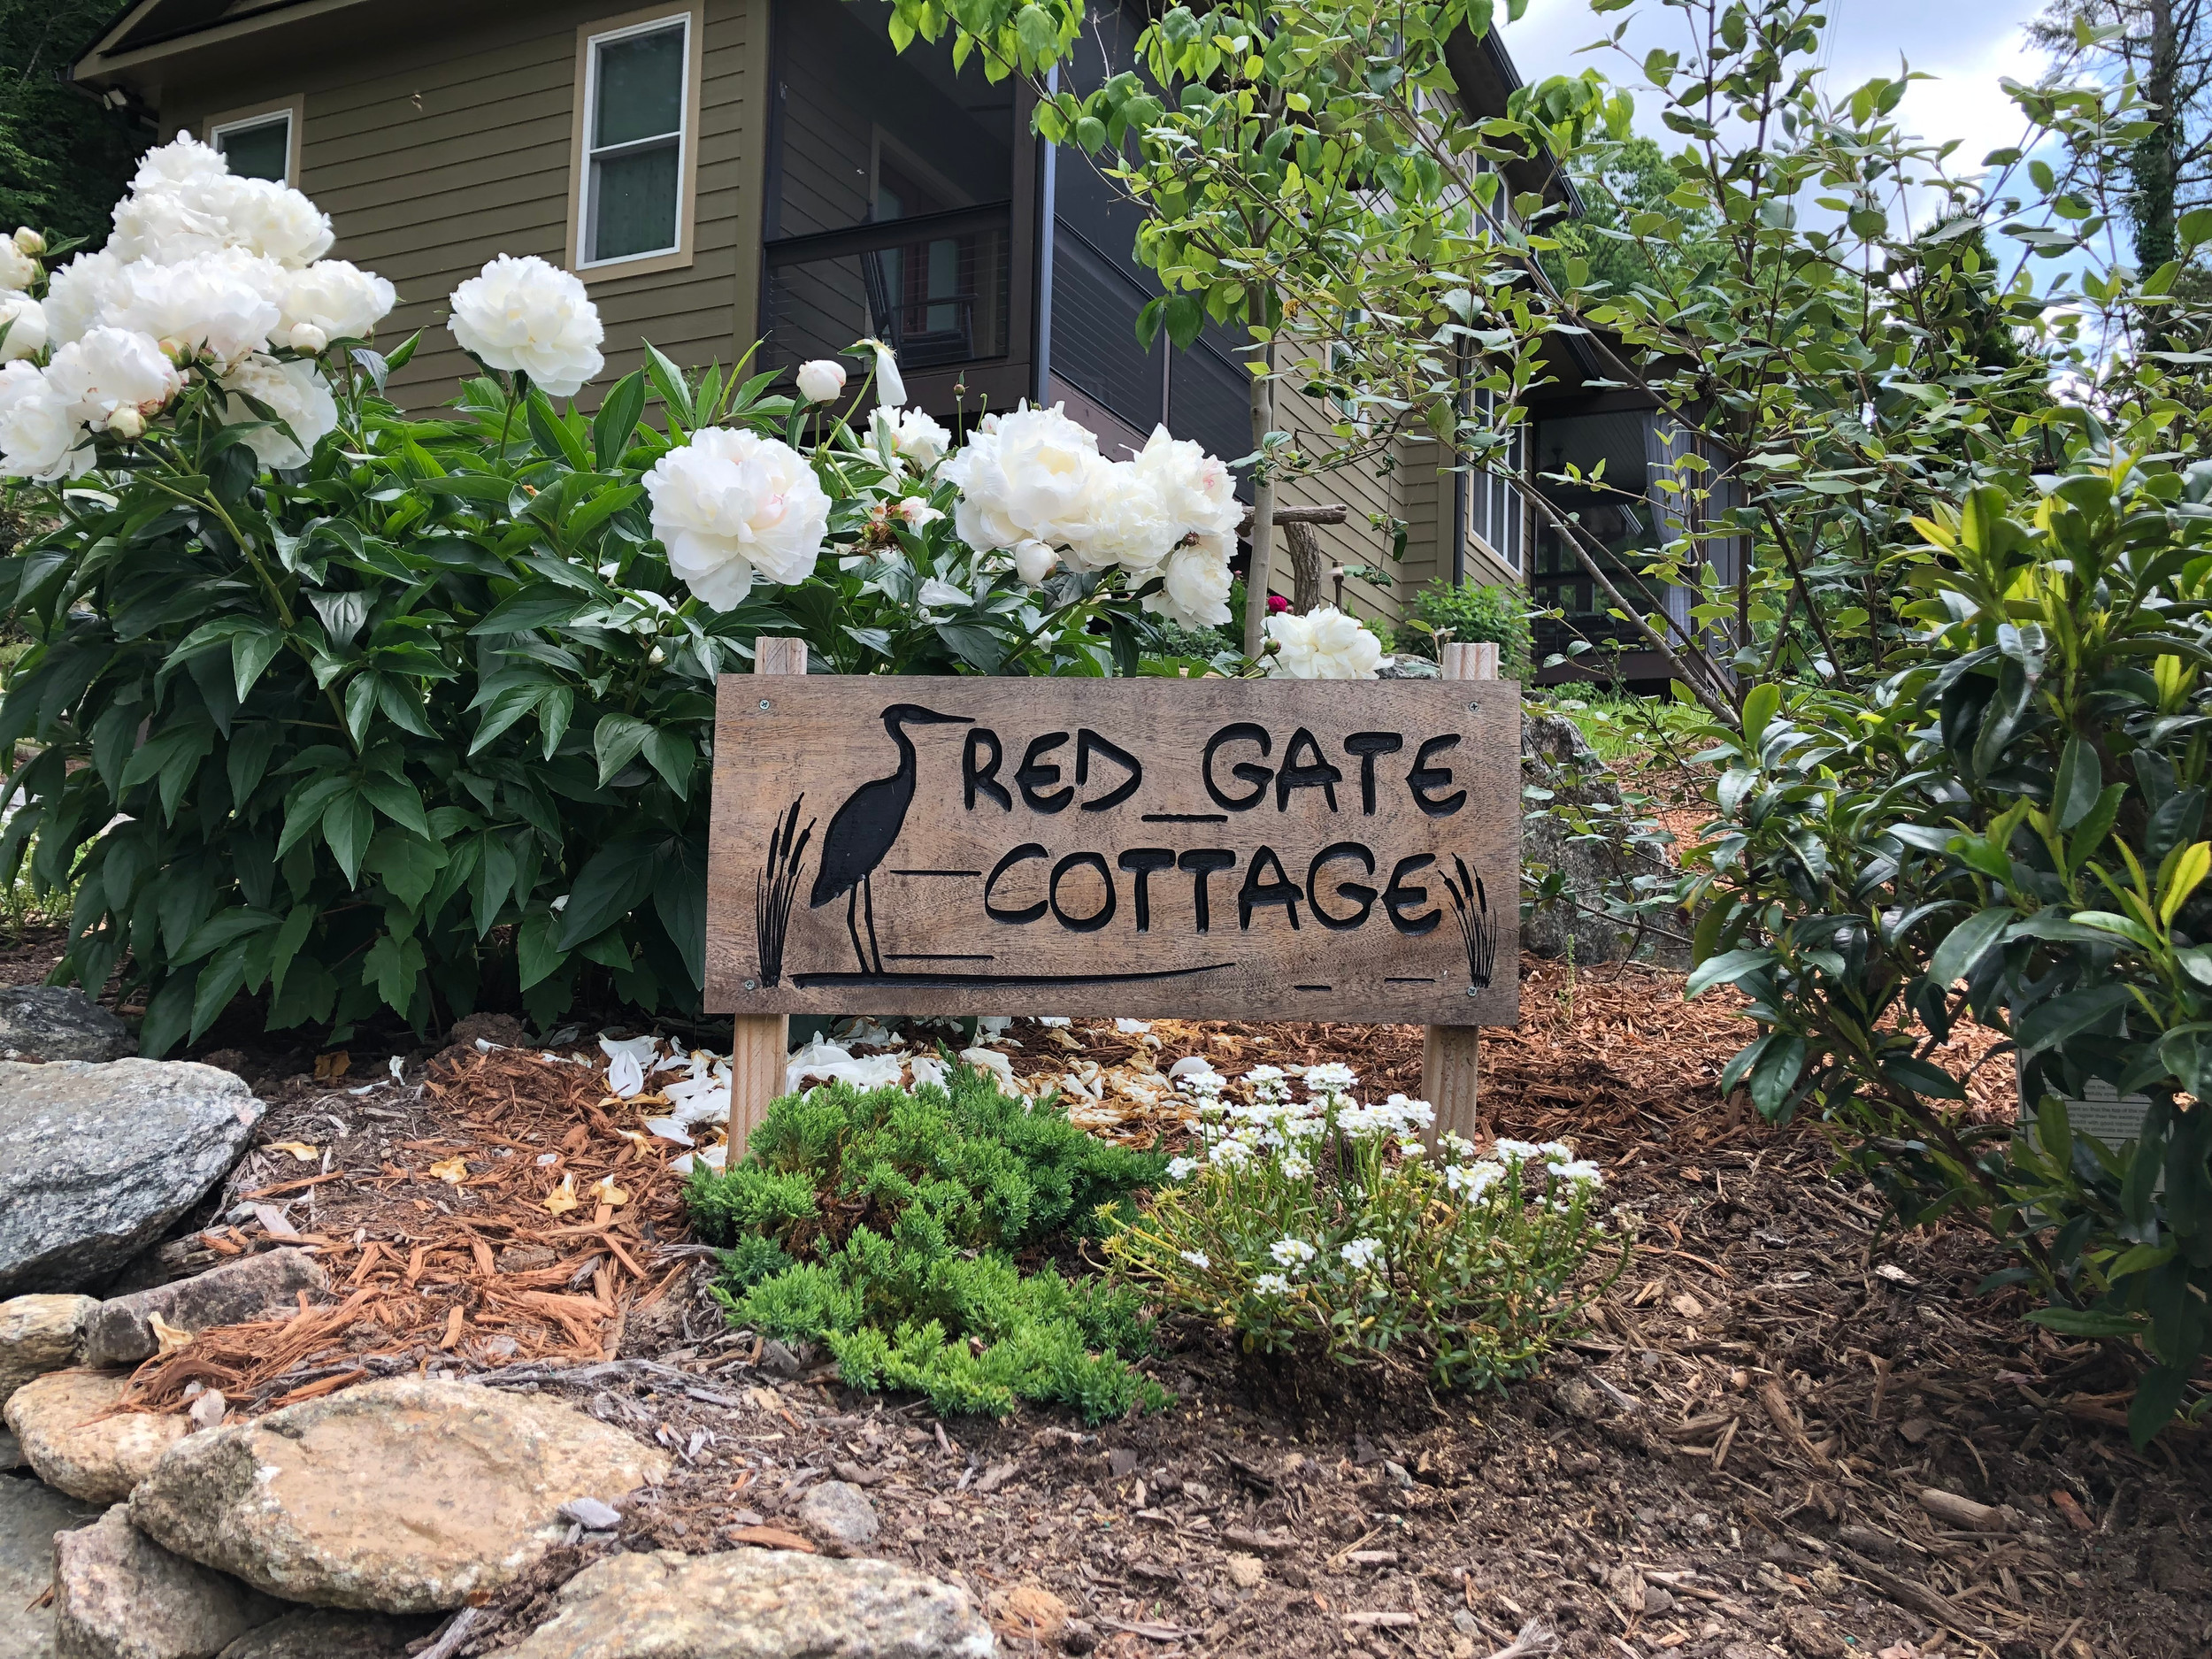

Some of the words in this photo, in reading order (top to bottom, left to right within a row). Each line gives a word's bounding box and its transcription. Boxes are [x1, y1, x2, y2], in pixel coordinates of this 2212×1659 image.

[963, 727, 1142, 814] RED
[1202, 722, 1467, 817] GATE
[984, 841, 1442, 935] COTTAGE
